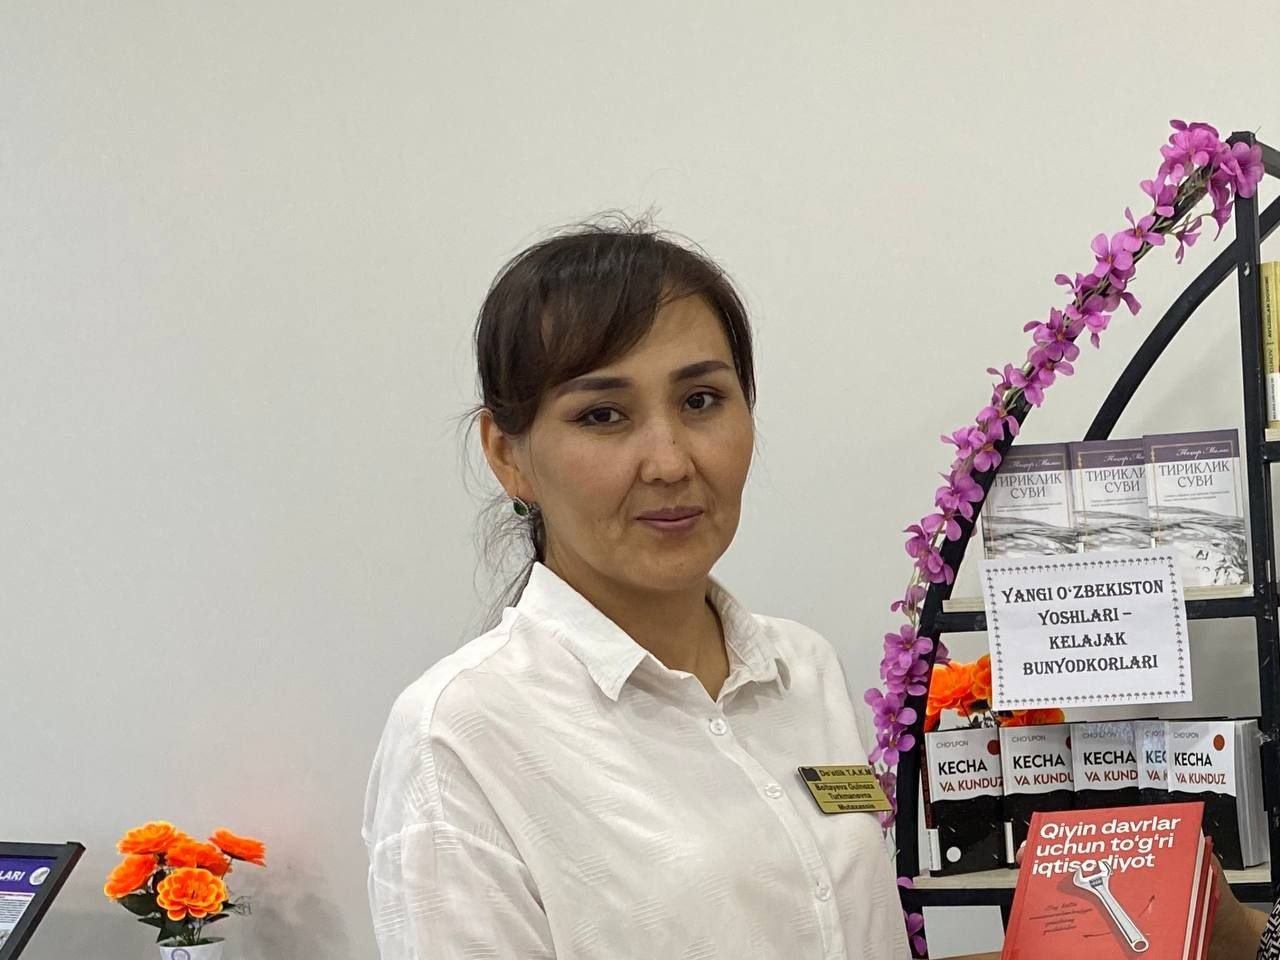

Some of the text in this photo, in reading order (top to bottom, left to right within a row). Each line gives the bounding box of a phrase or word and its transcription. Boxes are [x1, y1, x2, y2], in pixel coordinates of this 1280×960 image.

[1158, 460, 1230, 477] ТИРИКЛИК
[1104, 481, 1140, 493] СУВИ
[1177, 475, 1214, 489] СУВИ
[1010, 486, 1046, 499] СУВИ
[1001, 586, 1053, 604] YANGI
[1037, 607, 1119, 626] YOSHLARI
[1049, 631, 1127, 650] KELAJAK
[1023, 654, 1159, 676] BUNYODKORLARI
[1013, 754, 1065, 770] KECHA
[1083, 750, 1137, 765] KECHA
[1174, 752, 1213, 767] KECHA
[937, 759, 988, 776] KECHA
[1014, 771, 1073, 786] VA KUNDU
[1084, 769, 1138, 783] VA KUND
[1147, 770, 1161, 781] VA
[1175, 773, 1226, 785] VA KUNDUZ
[939, 781, 955, 793] VA
[1040, 816, 1181, 843] Qiyin davrlar
[1036, 839, 1105, 857] uchun
